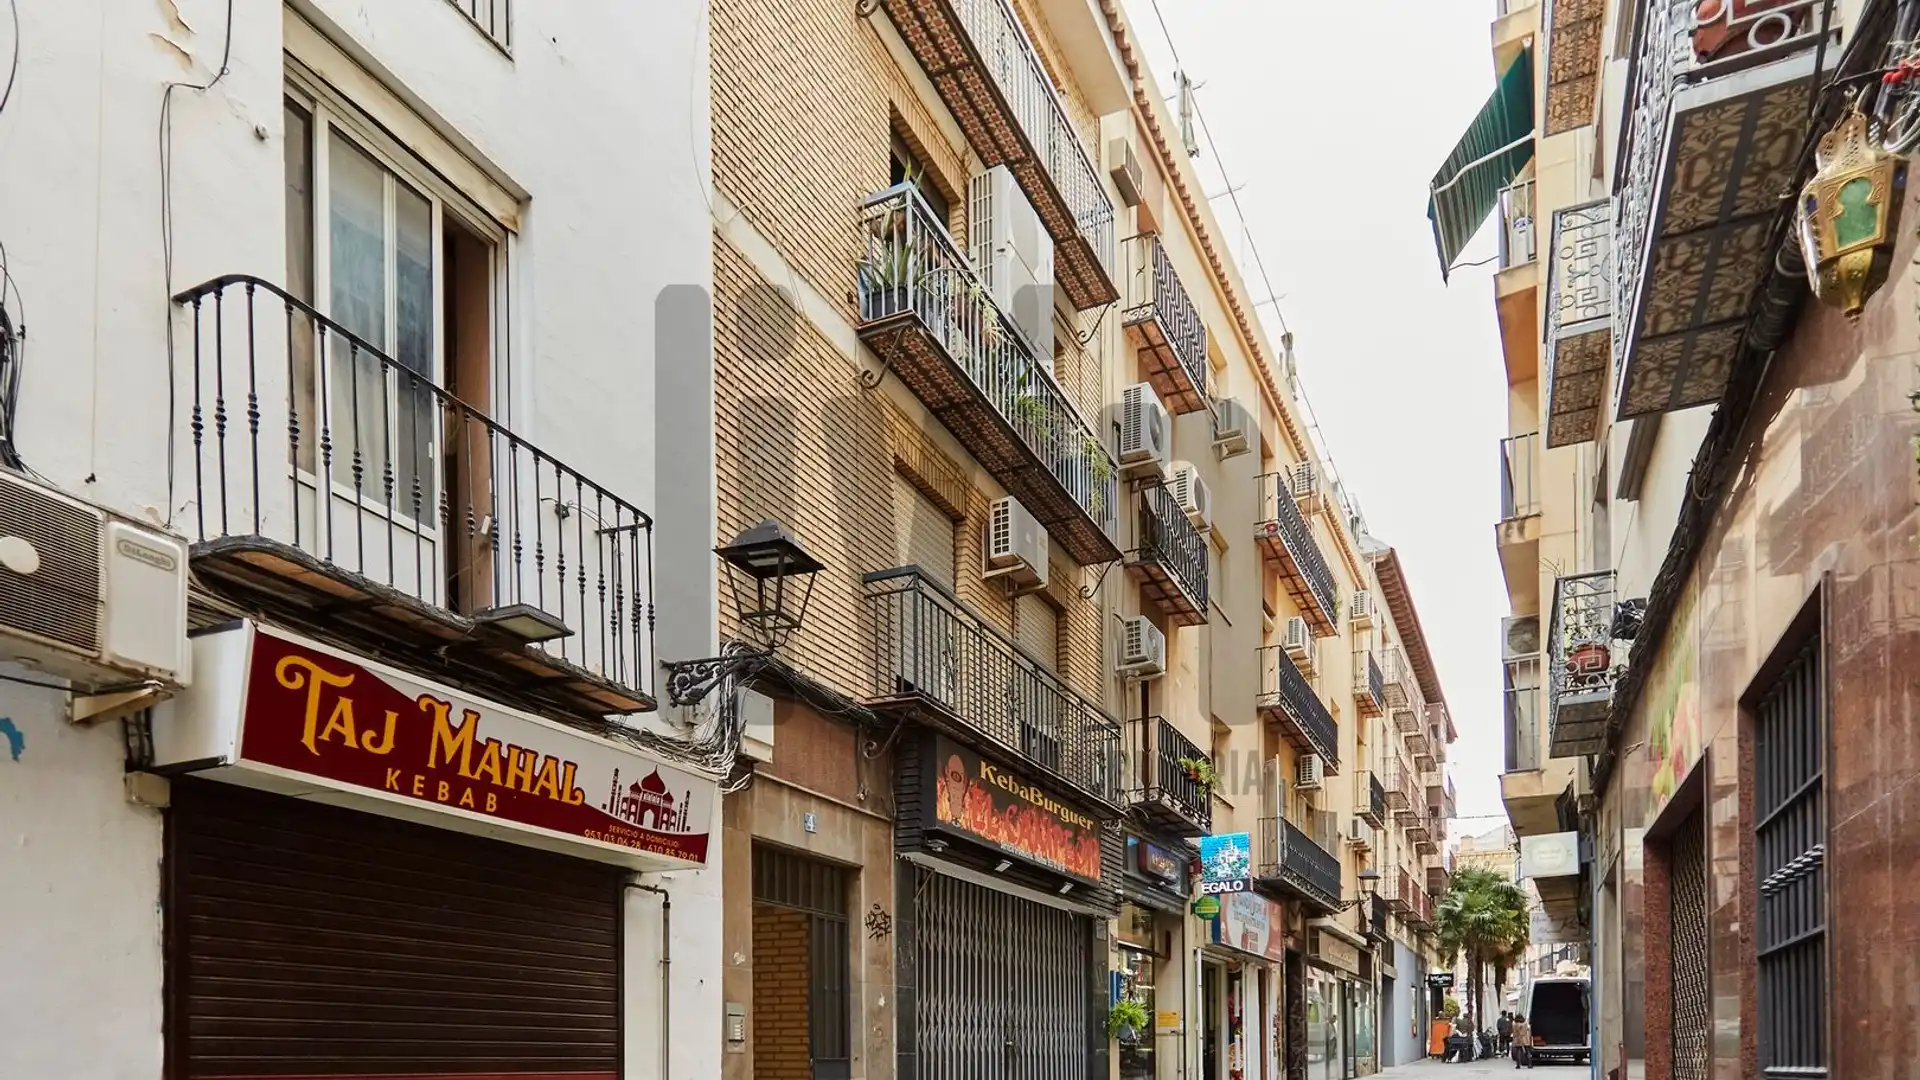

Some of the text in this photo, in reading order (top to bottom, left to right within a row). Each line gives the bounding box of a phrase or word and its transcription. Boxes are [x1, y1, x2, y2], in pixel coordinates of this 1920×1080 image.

[385, 767, 497, 812] KEBAB
[979, 760, 1094, 831] KebaBurguer
[609, 825, 638, 838] SERVICIO
[640, 831, 645, 840] A
[1201, 880, 1244, 895] EGALO
